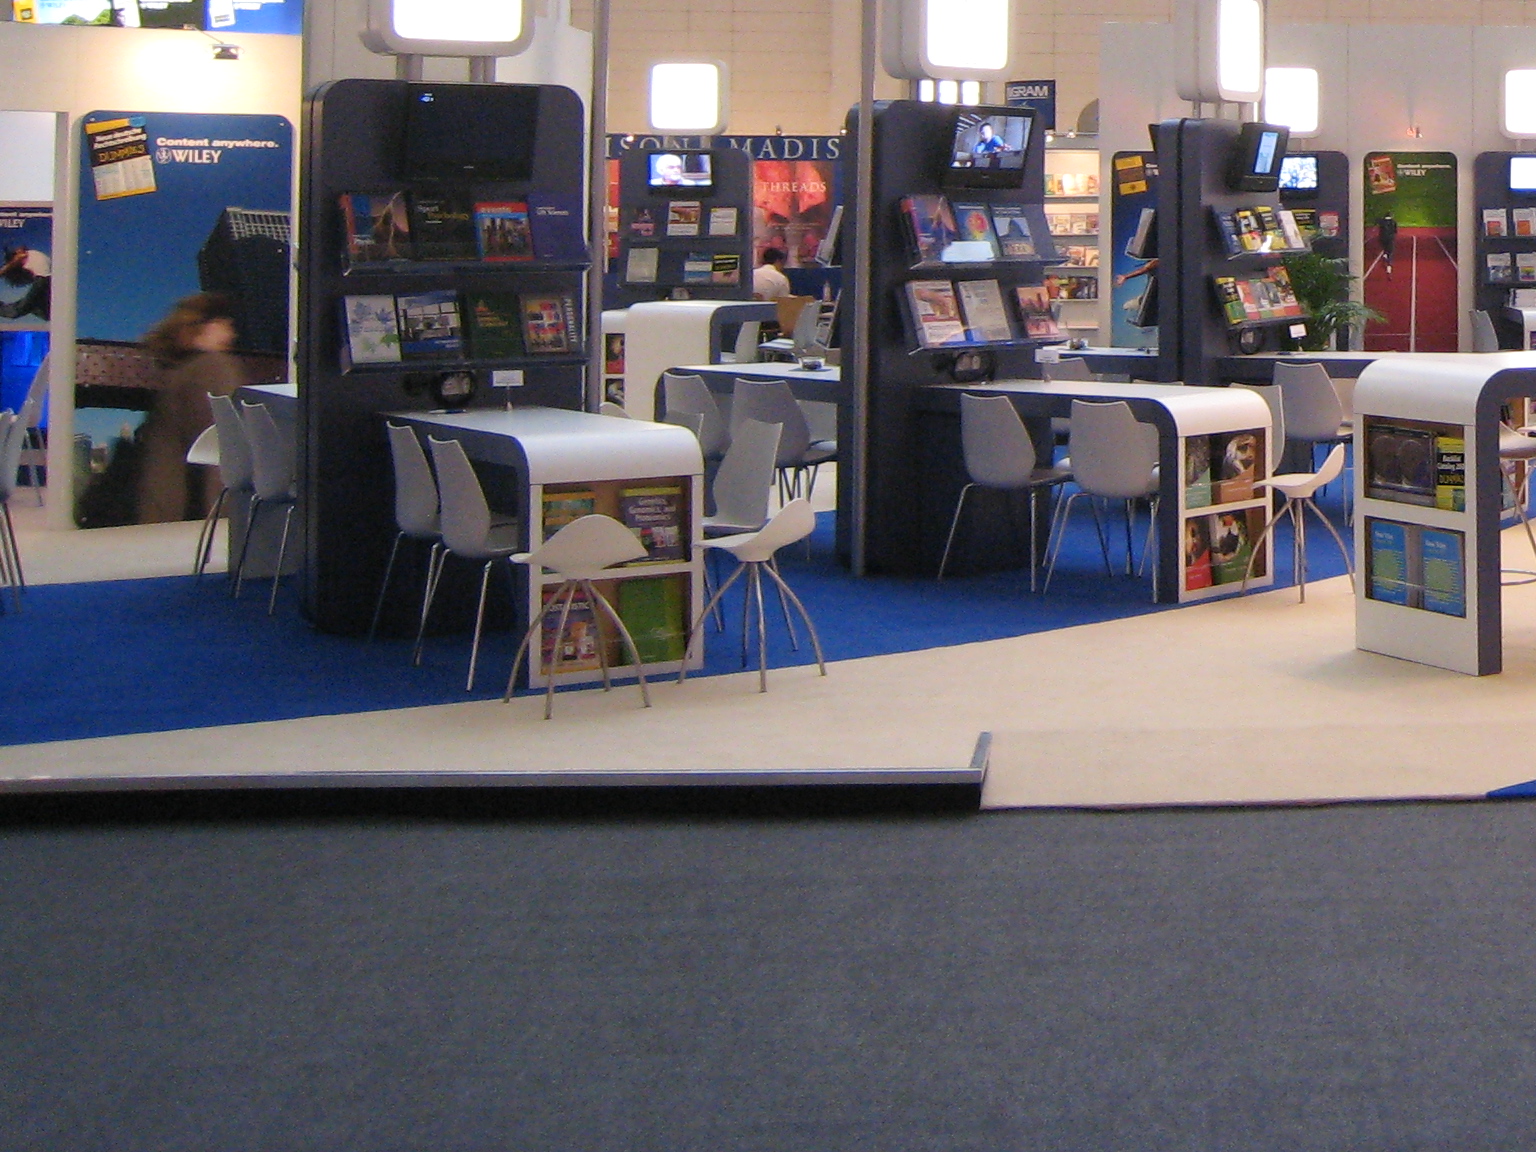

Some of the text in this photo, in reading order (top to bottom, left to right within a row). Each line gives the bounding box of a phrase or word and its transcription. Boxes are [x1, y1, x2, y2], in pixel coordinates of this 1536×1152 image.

[156, 137, 210, 148] Content
[211, 138, 280, 149] anywhere.
[171, 149, 222, 164] WILEY
[762, 181, 827, 194] THREADS
